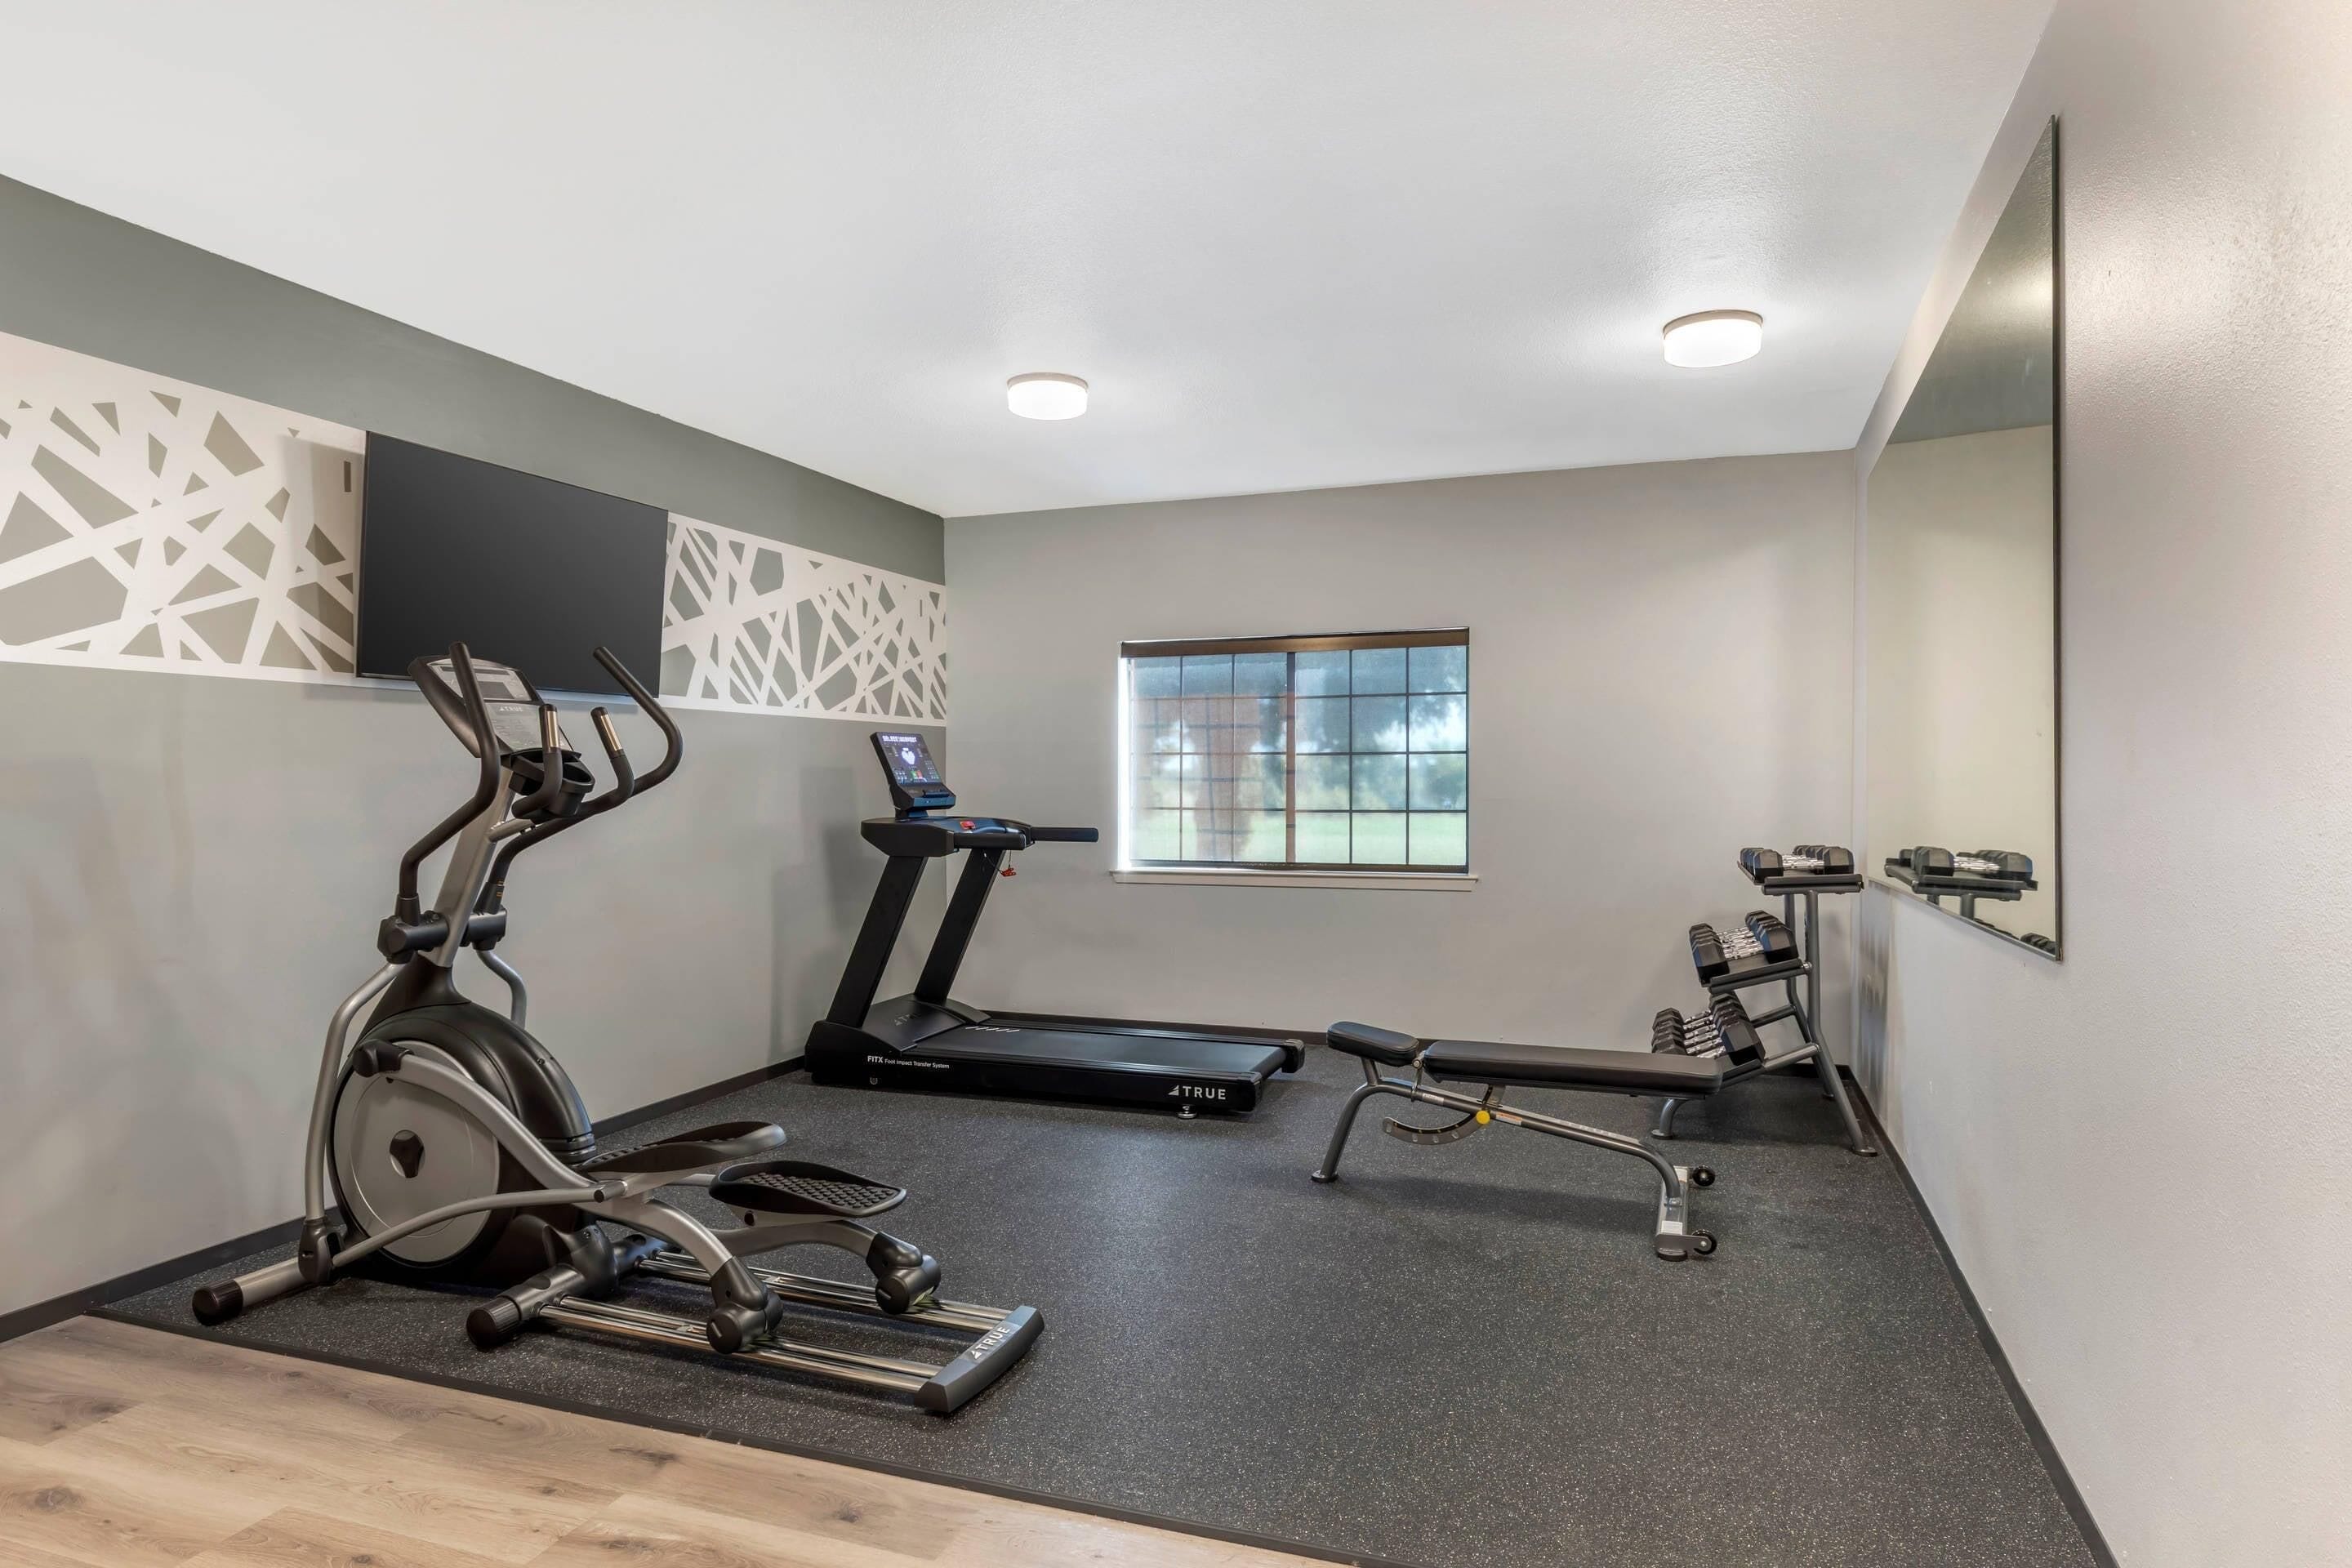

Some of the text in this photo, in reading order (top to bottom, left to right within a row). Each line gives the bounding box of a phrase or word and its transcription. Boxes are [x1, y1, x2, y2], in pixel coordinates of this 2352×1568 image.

[867, 1055, 884, 1063] FITX
[1182, 1085, 1226, 1100] TRUE
[975, 1326, 1011, 1350] TRUE
